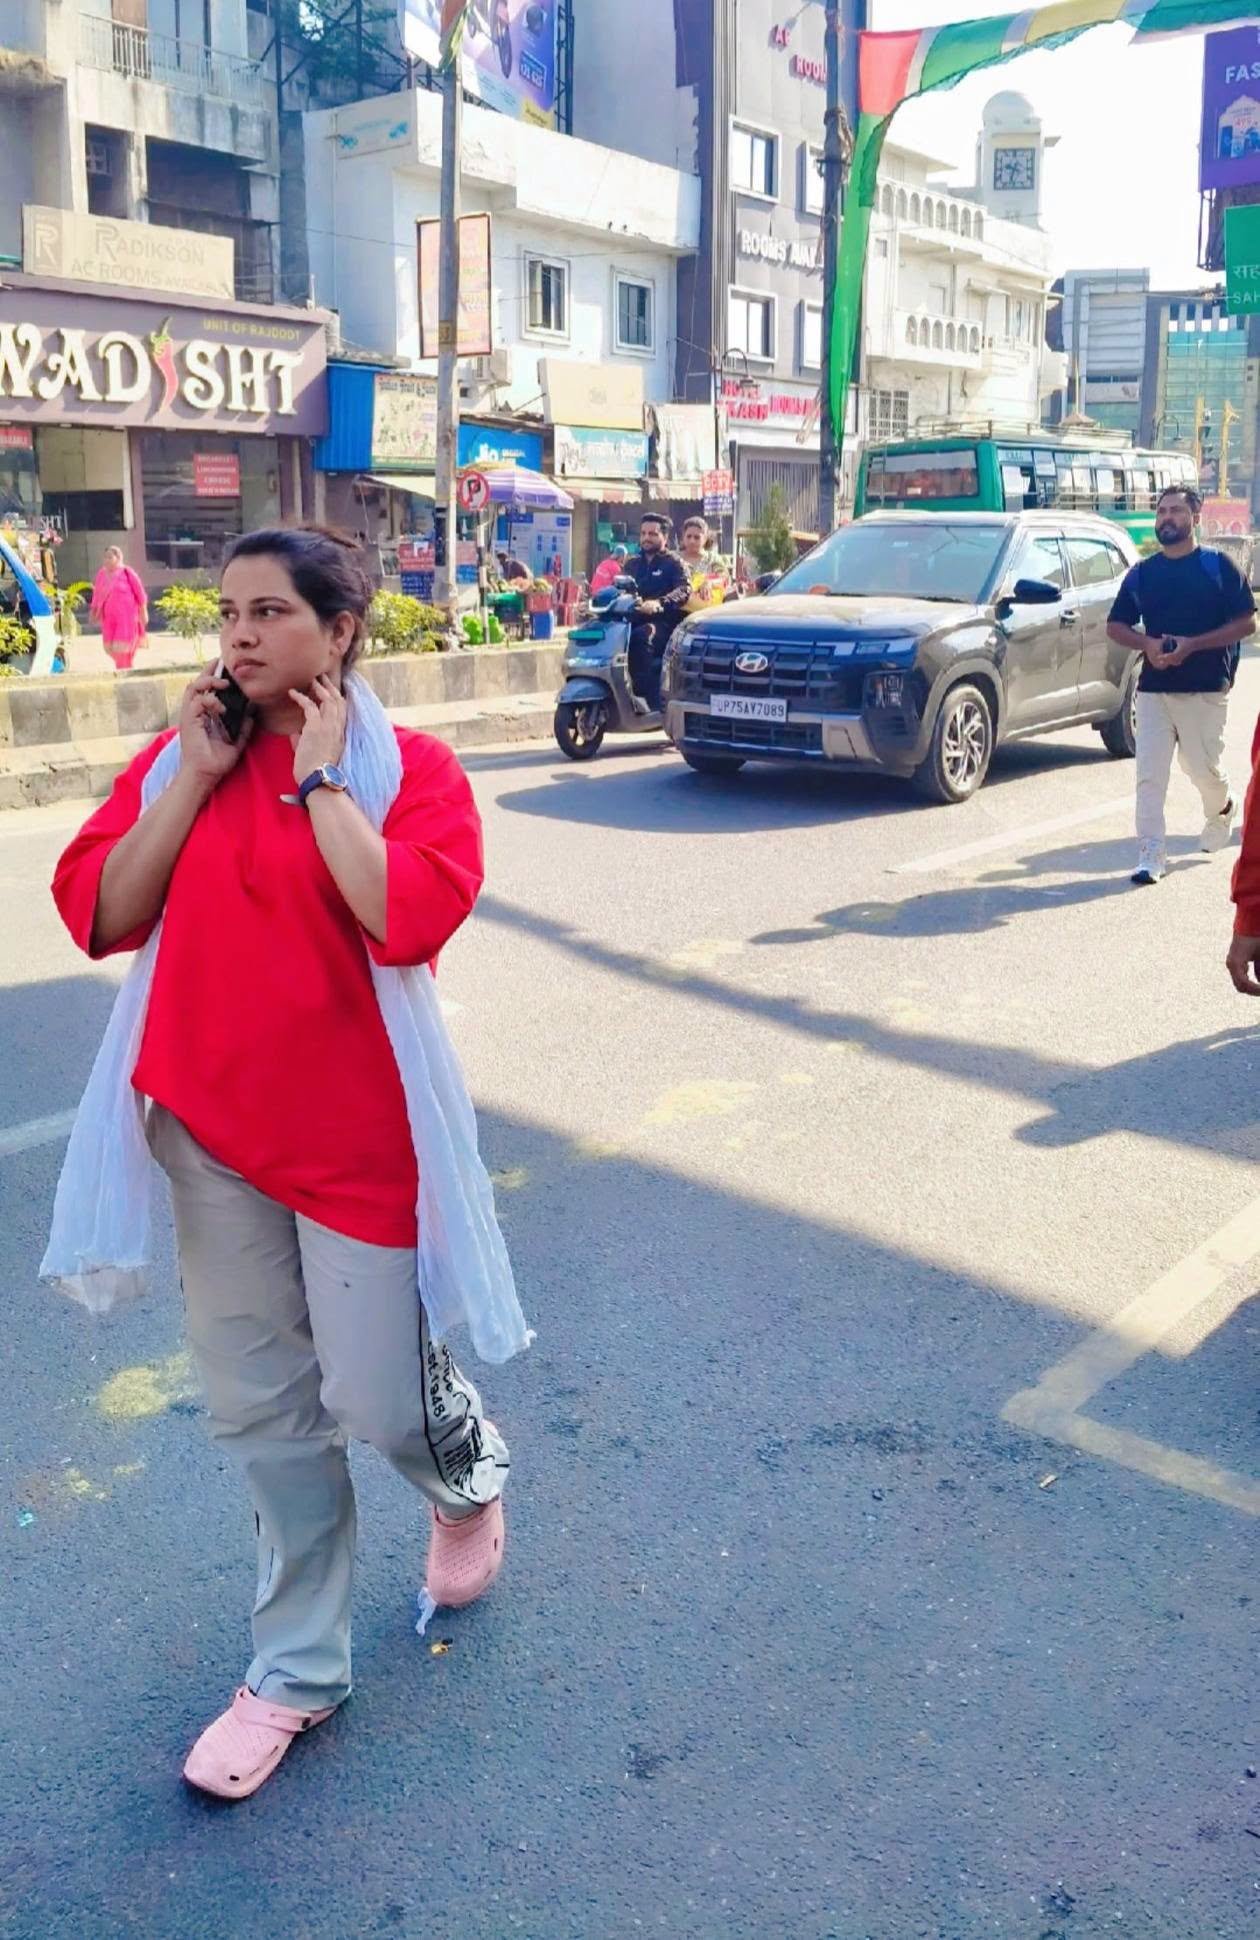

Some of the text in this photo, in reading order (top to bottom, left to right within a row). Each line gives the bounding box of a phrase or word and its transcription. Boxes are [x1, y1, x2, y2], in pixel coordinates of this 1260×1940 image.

[99, 262, 163, 287] ROOMS
[203, 318, 229, 332] UNIT
[232, 321, 247, 334] OF
